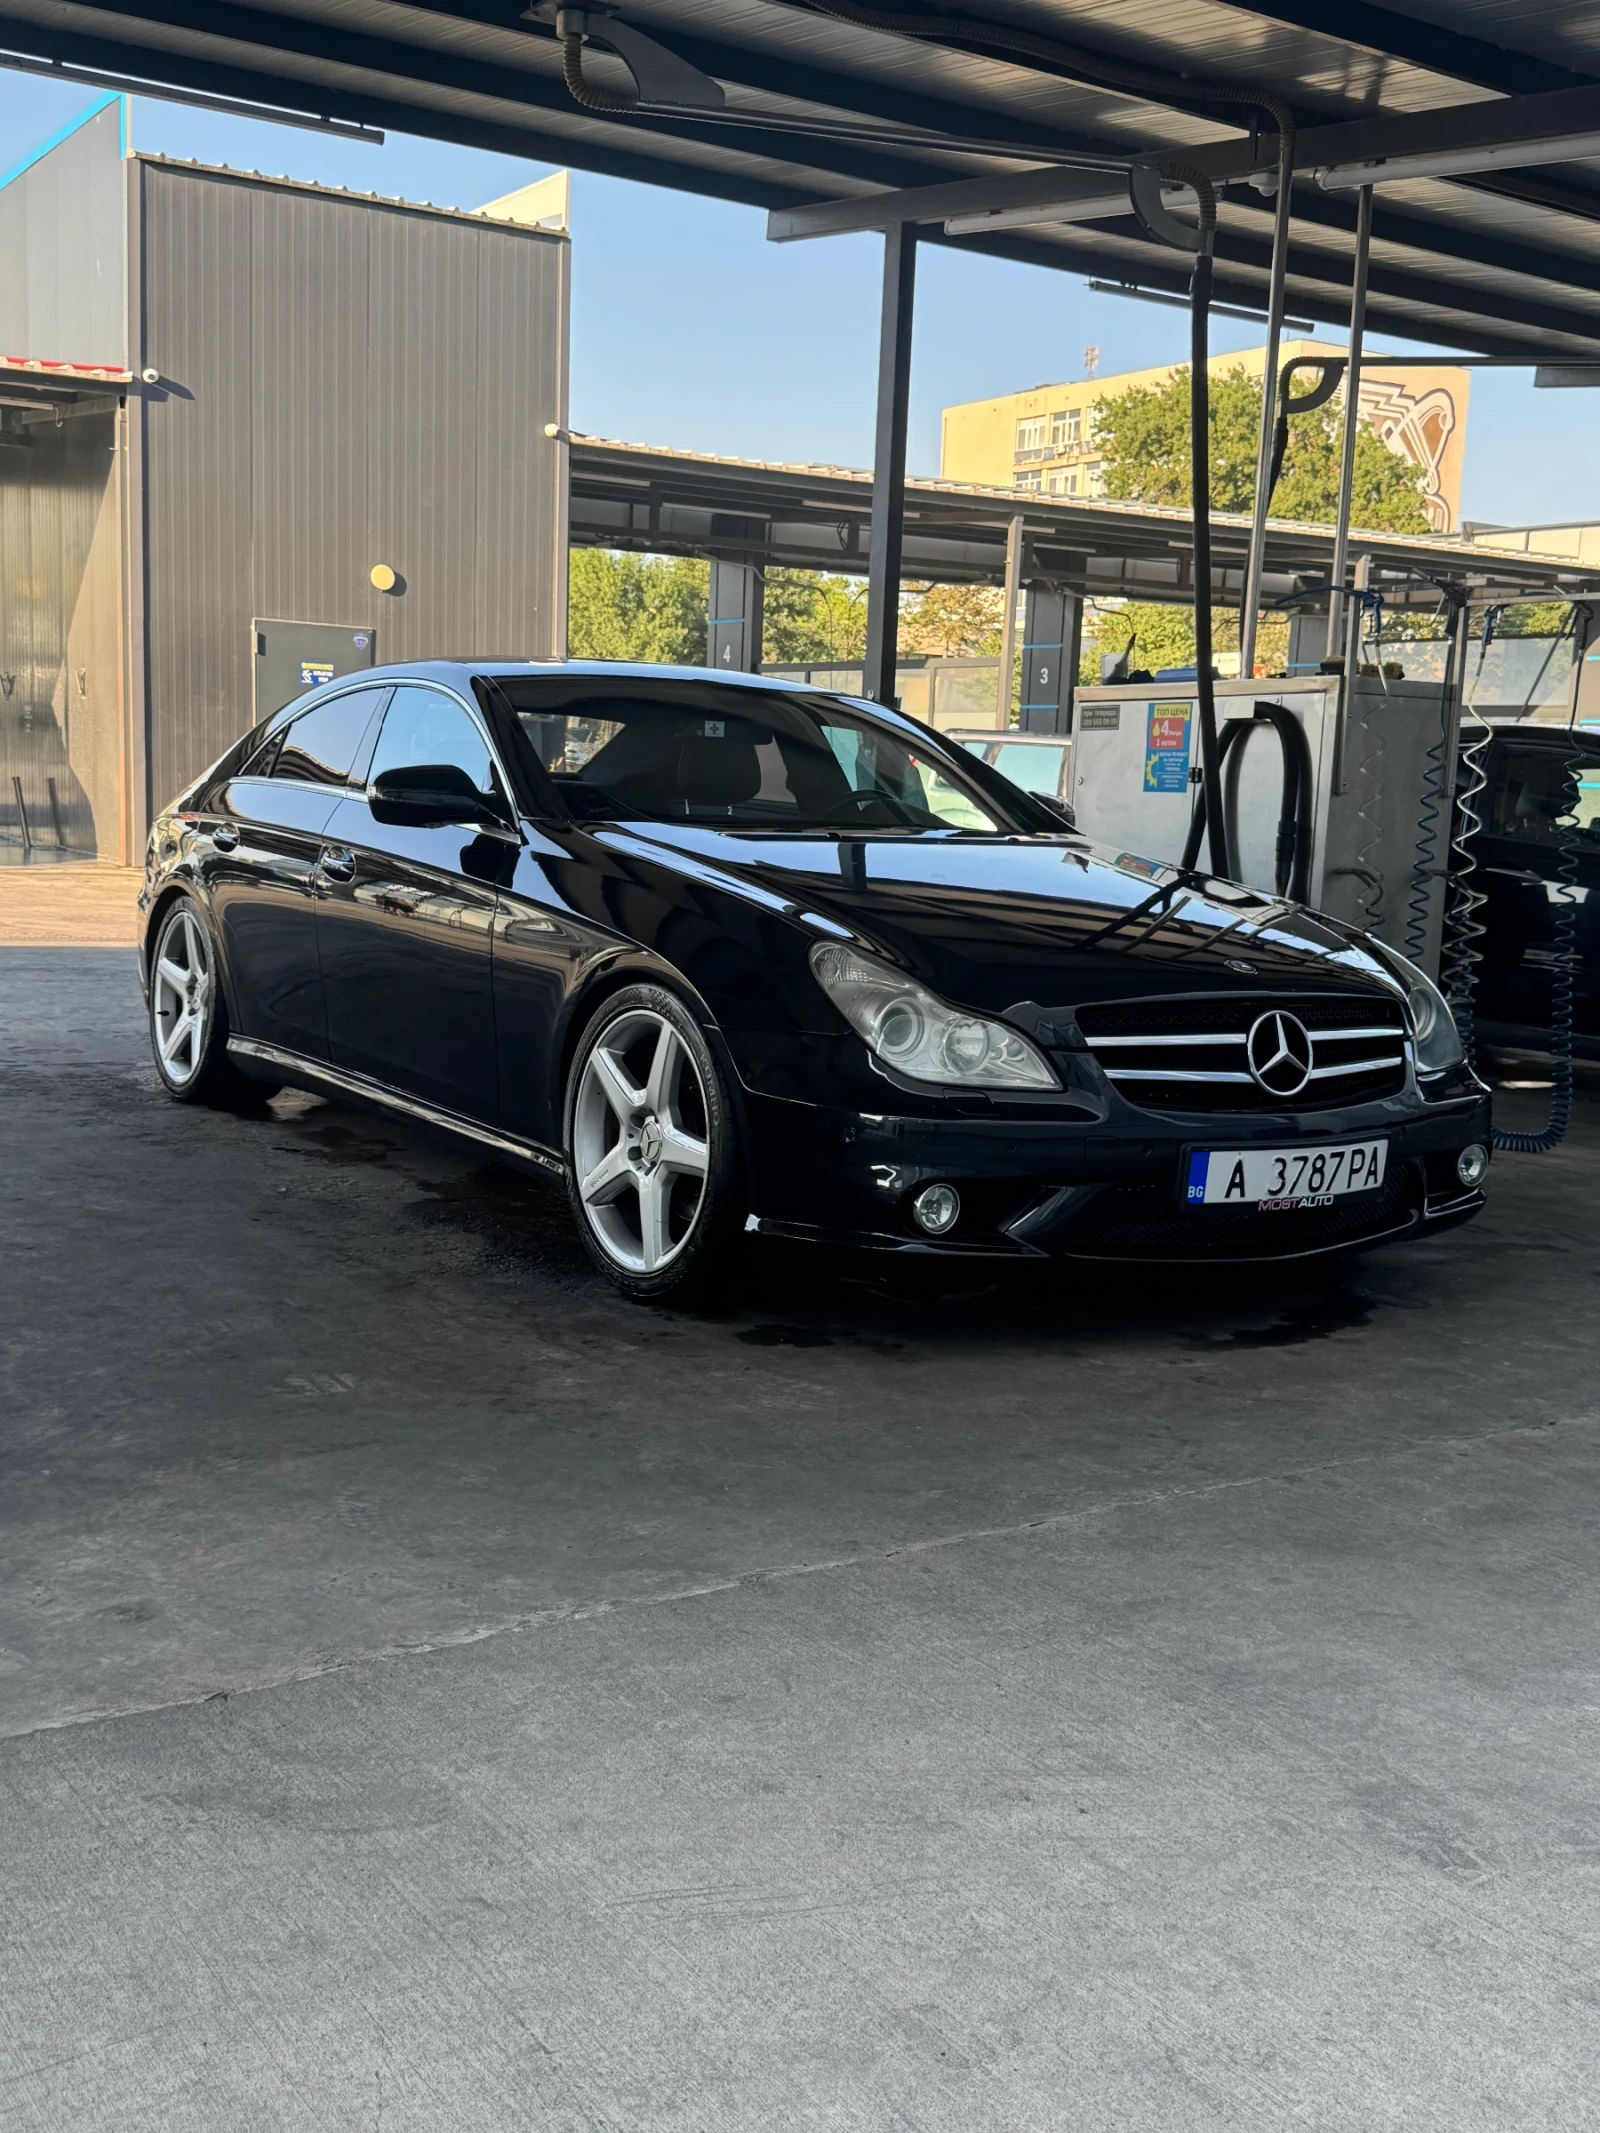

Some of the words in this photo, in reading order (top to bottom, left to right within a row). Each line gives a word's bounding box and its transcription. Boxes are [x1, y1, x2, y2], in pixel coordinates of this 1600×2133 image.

[723, 644, 731, 663] 4
[1040, 667, 1049, 685] 3
[1156, 708, 1170, 717] ТОП
[1170, 707, 1188, 717] ЦЕНА
[1160, 719, 1169, 736] 4
[1224, 1154, 1246, 1199] A
[1187, 1185, 1204, 1198] BG
